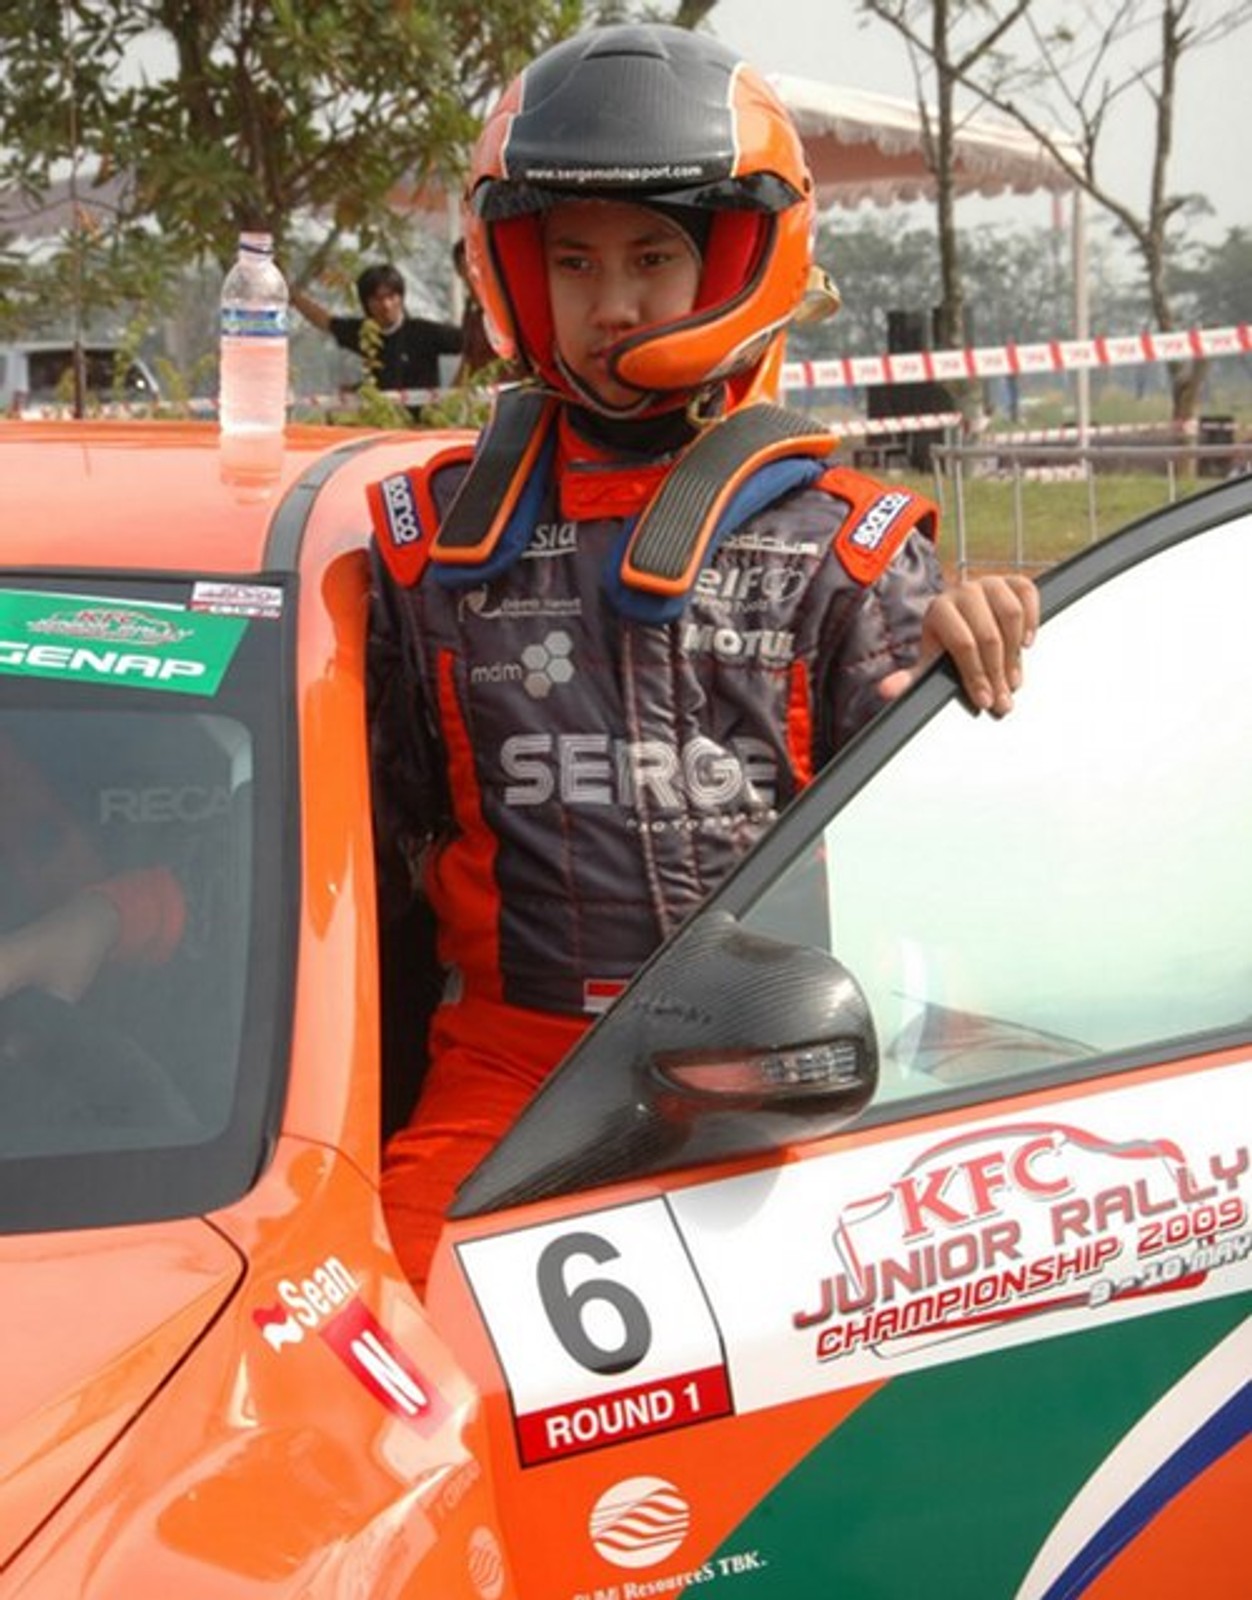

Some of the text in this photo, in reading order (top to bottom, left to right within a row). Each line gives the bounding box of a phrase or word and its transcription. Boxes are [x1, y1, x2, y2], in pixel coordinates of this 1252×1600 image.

[470, 662, 523, 684] mdm
[500, 733, 777, 805] SERGE
[891, 1138, 1070, 1240] KFC
[793, 1147, 1250, 1330] JUNIOR RALLY
[815, 1196, 1246, 1363] CHAMPIONSHIP 2009
[277, 1256, 360, 1329] Sean
[536, 1231, 652, 1376] 6
[545, 1382, 702, 1449] ROUND 1
